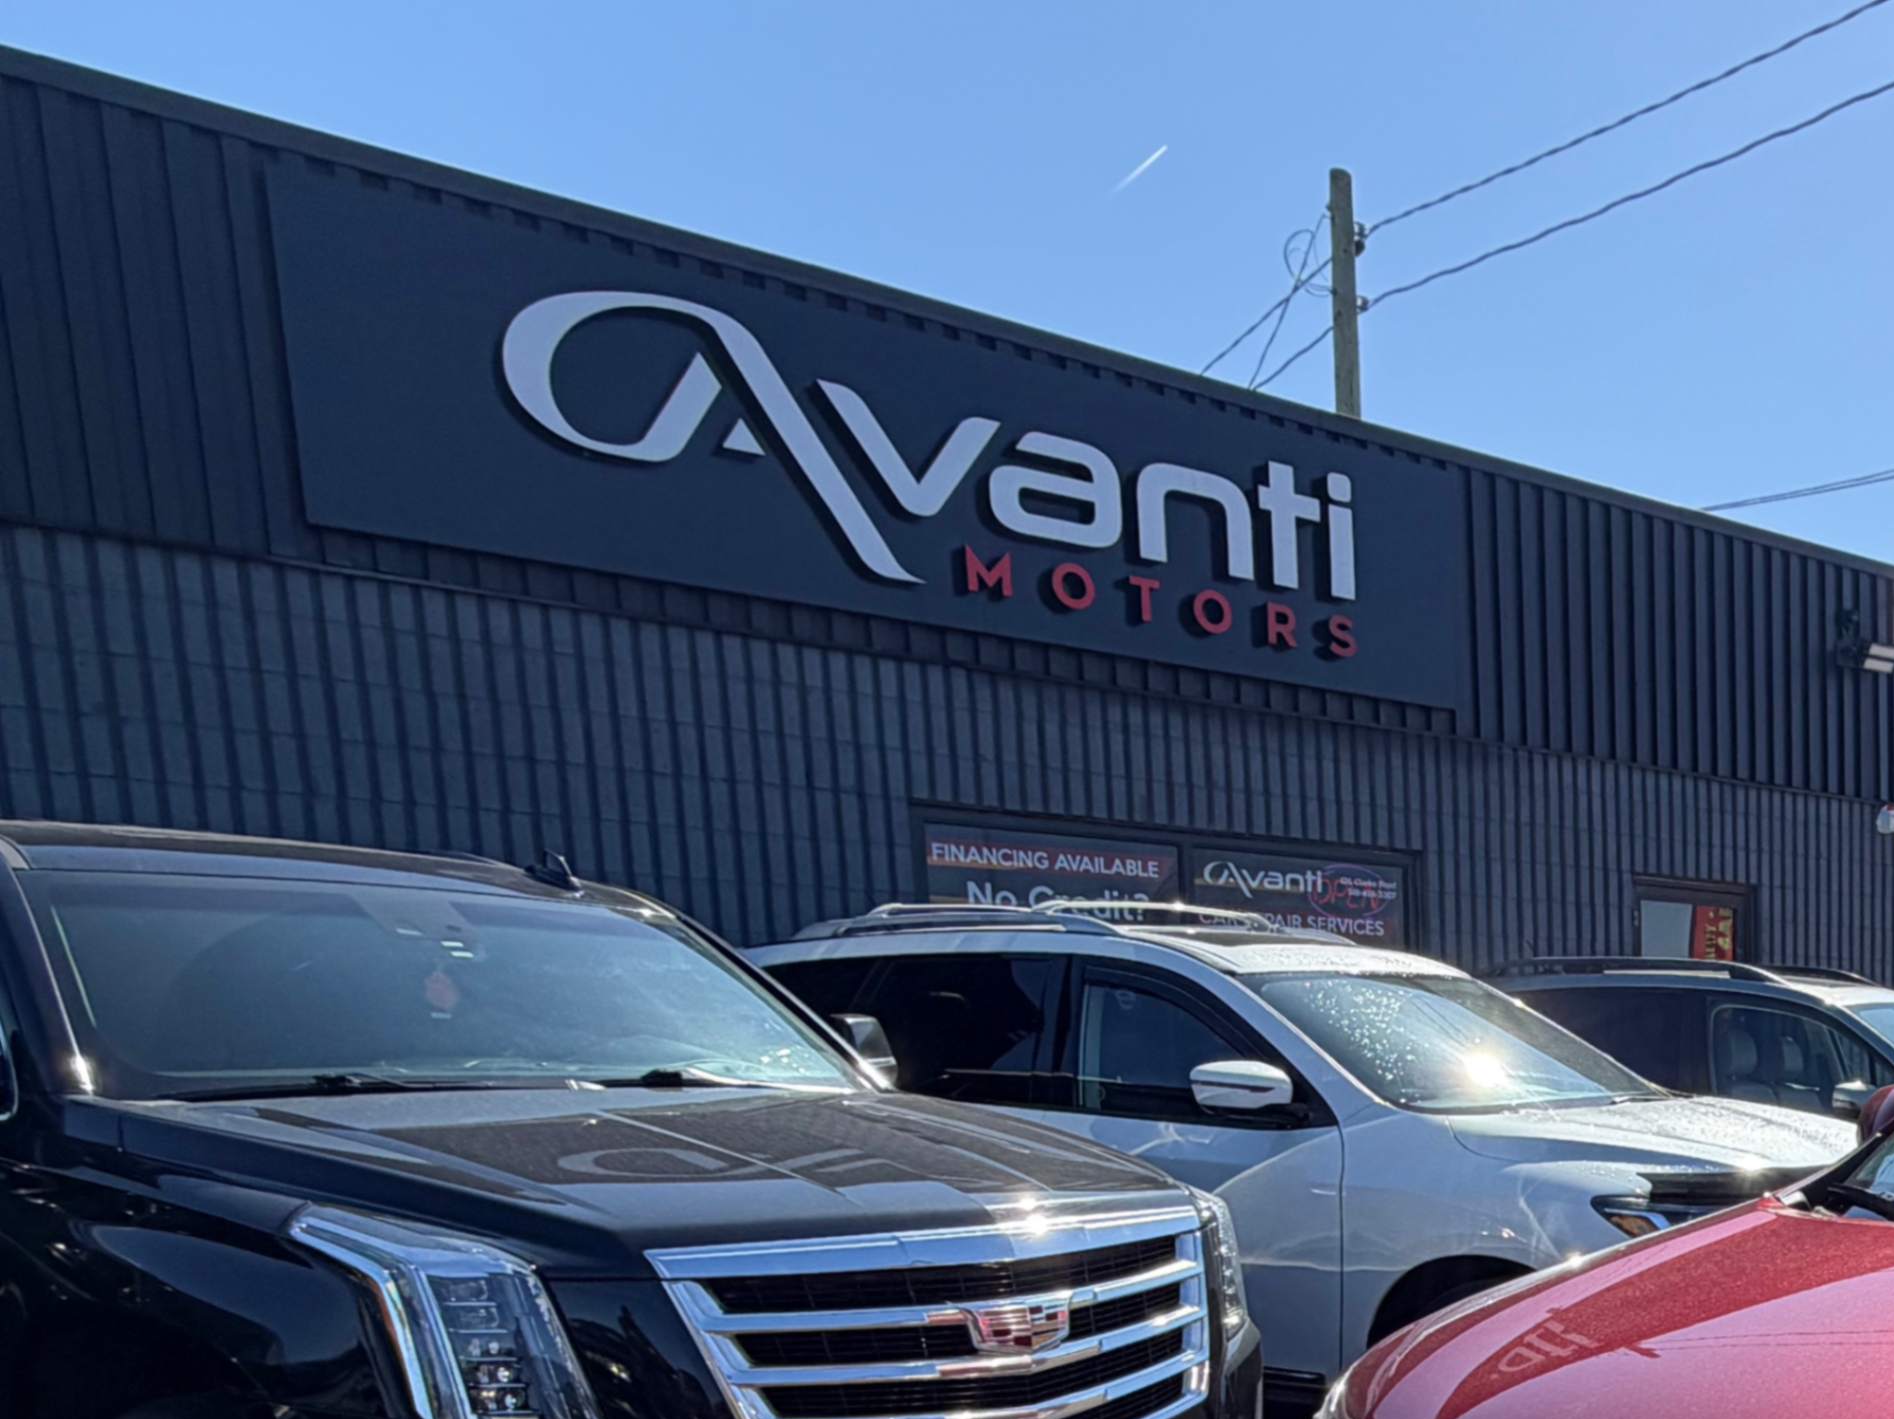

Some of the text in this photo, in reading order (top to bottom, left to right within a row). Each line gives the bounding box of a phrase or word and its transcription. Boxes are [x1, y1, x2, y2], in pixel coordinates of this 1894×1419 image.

[502, 290, 1355, 600] Avanti
[964, 544, 1357, 658] MOTORS
[931, 841, 1159, 879] FINANCING AVAILABLE
[966, 880, 1018, 906] No
[1203, 860, 1323, 899] Avanti
[1307, 915, 1385, 937] SERVICES
